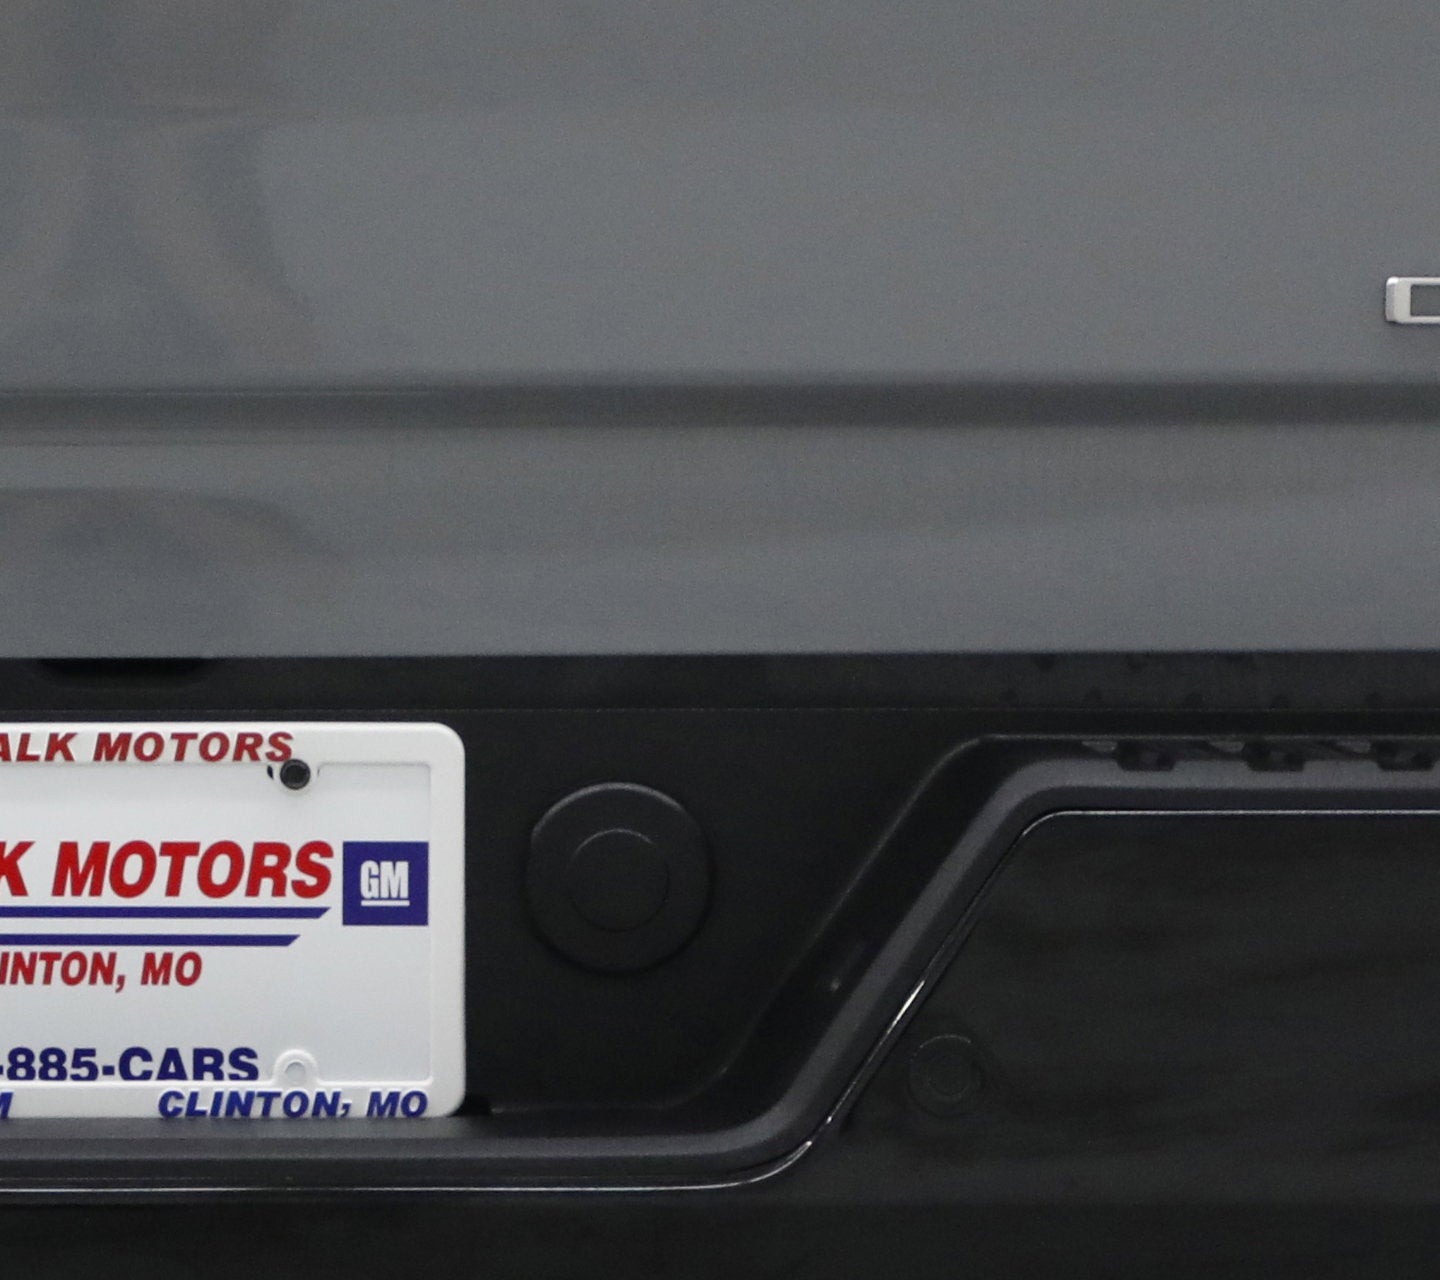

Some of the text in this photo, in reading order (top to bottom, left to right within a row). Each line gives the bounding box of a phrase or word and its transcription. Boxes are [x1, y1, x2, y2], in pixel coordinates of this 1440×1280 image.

[92, 731, 295, 763] MOTORS
[51, 840, 335, 899] MOTORS
[360, 859, 410, 901] GM
[139, 951, 204, 987] MO
[157, 1090, 430, 1119] CLINTON, MO
